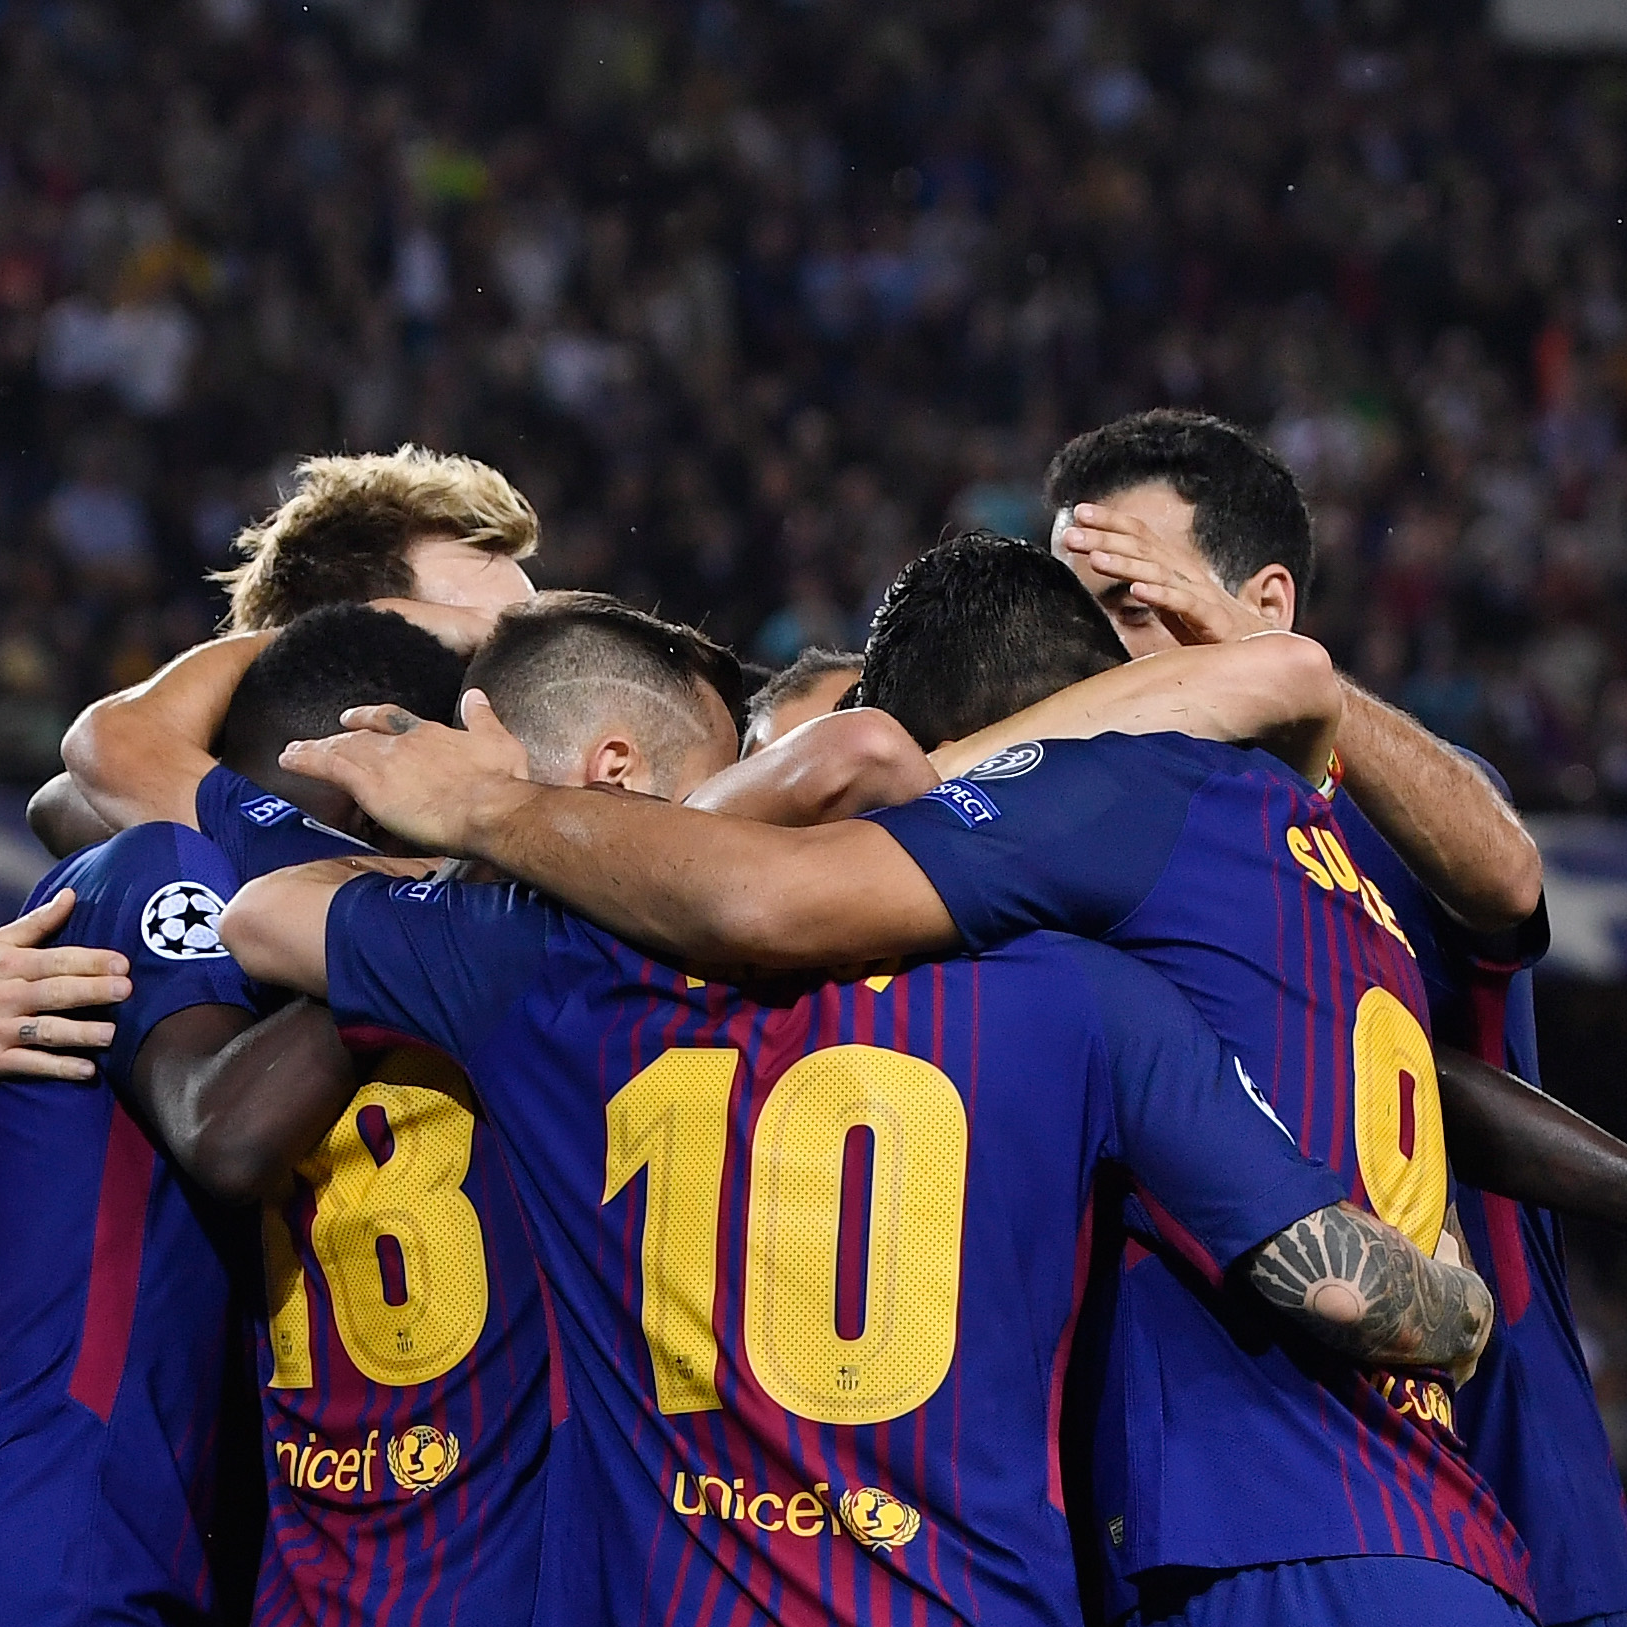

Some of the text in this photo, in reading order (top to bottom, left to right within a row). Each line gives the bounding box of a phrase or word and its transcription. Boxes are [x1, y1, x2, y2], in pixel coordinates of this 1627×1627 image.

[262, 1048, 488, 1389] 18
[601, 1044, 969, 1425] 10
[1353, 986, 1447, 1258] 9
[276, 1430, 379, 1492] nicef
[673, 1472, 842, 1537] unicef
